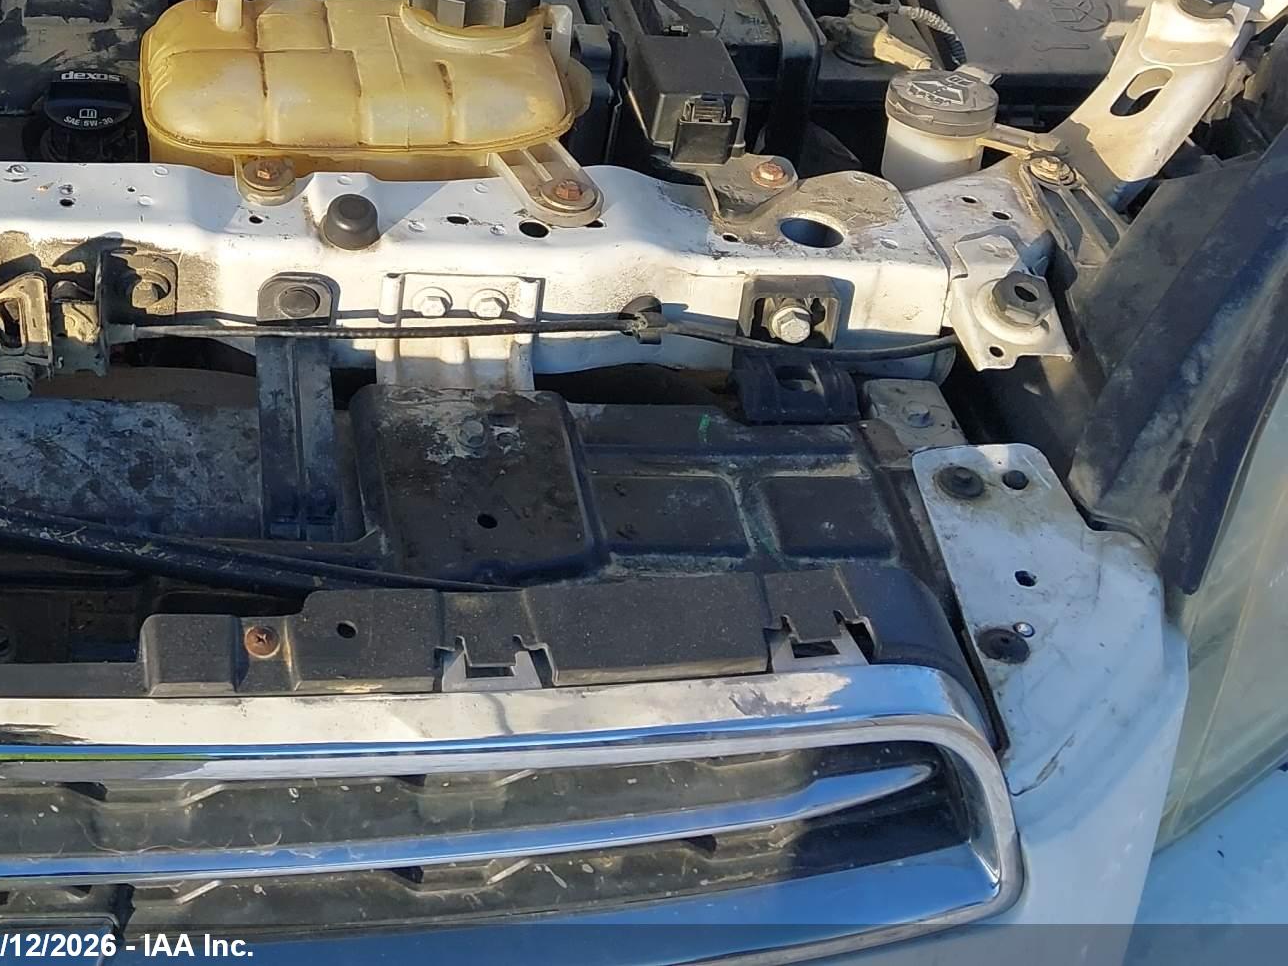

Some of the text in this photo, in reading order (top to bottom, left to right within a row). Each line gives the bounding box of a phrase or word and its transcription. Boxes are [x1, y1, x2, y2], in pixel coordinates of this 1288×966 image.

[61, 70, 121, 82] dexos
[63, 115, 114, 127] SAE 5W-30
